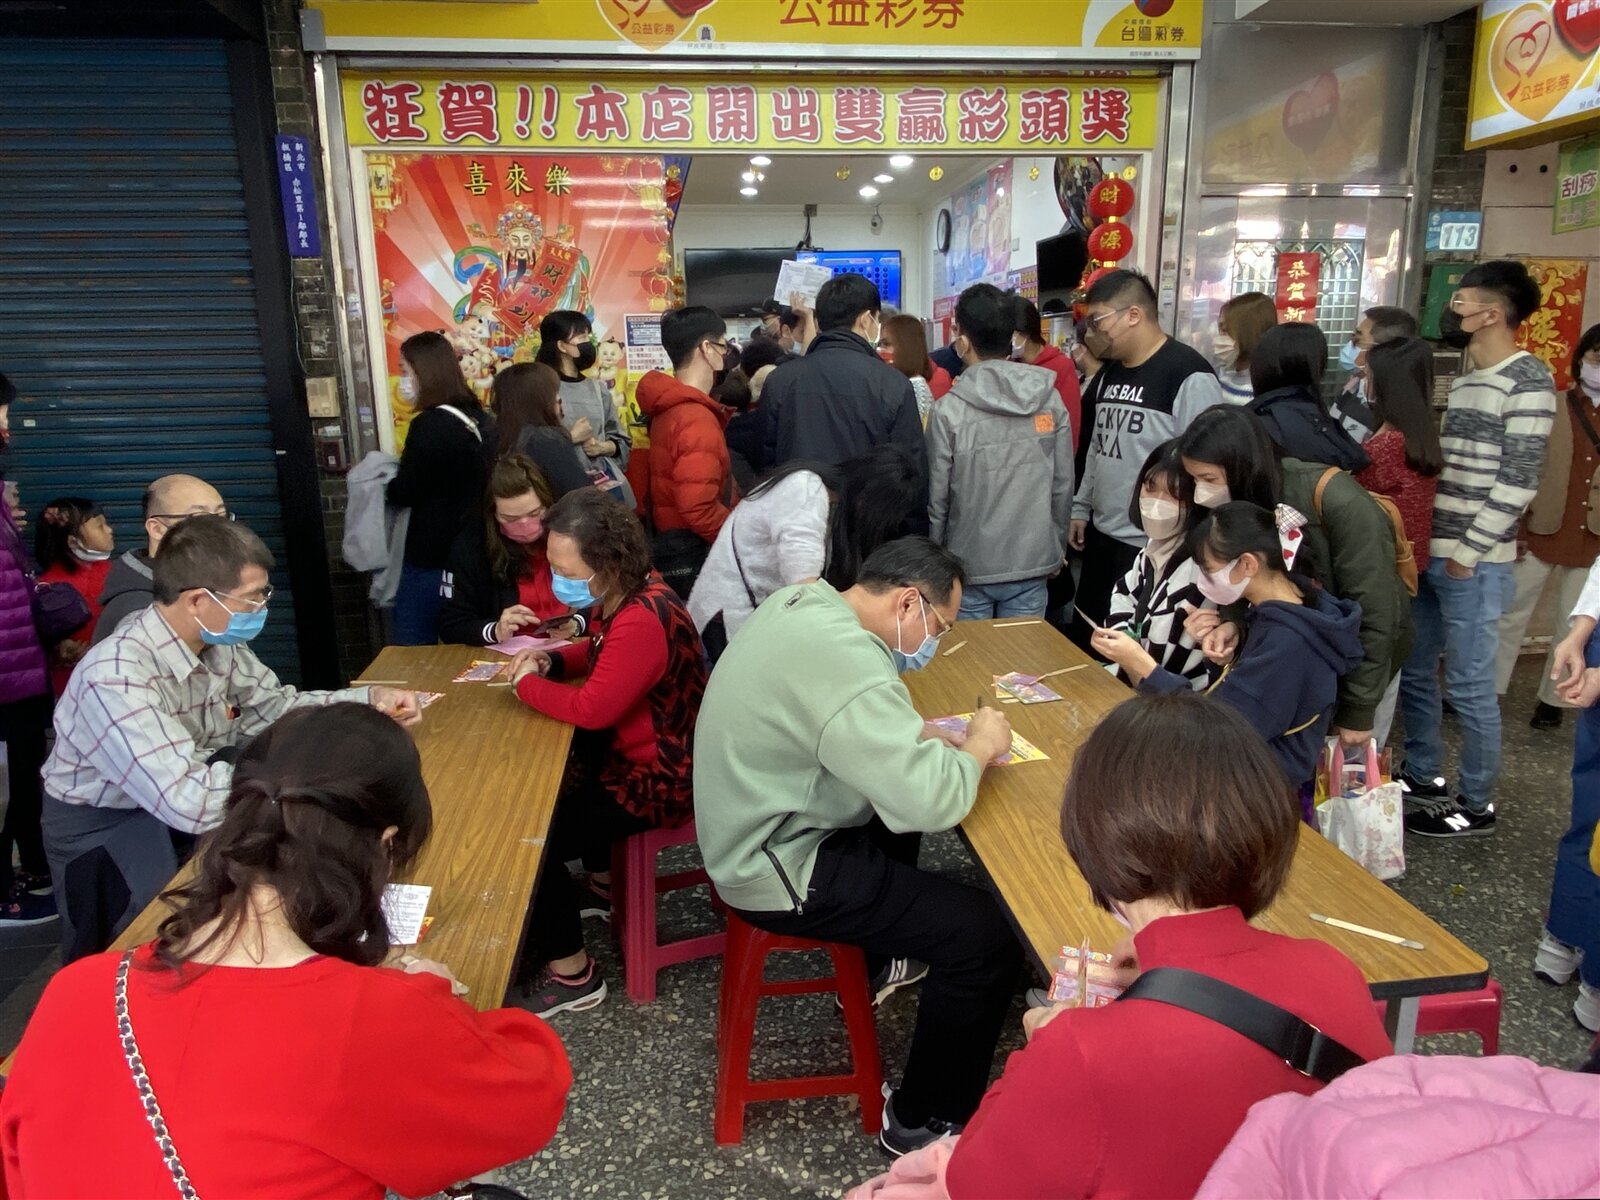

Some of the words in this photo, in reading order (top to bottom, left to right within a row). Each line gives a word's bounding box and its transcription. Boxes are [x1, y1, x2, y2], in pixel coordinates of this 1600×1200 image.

[631, 22, 675, 36] 公益彩券
[1519, 73, 1570, 102] 公益彩券
[464, 161, 572, 197] 喜來樂
[1442, 224, 1478, 248] 113
[1444, 812, 1471, 832] N
